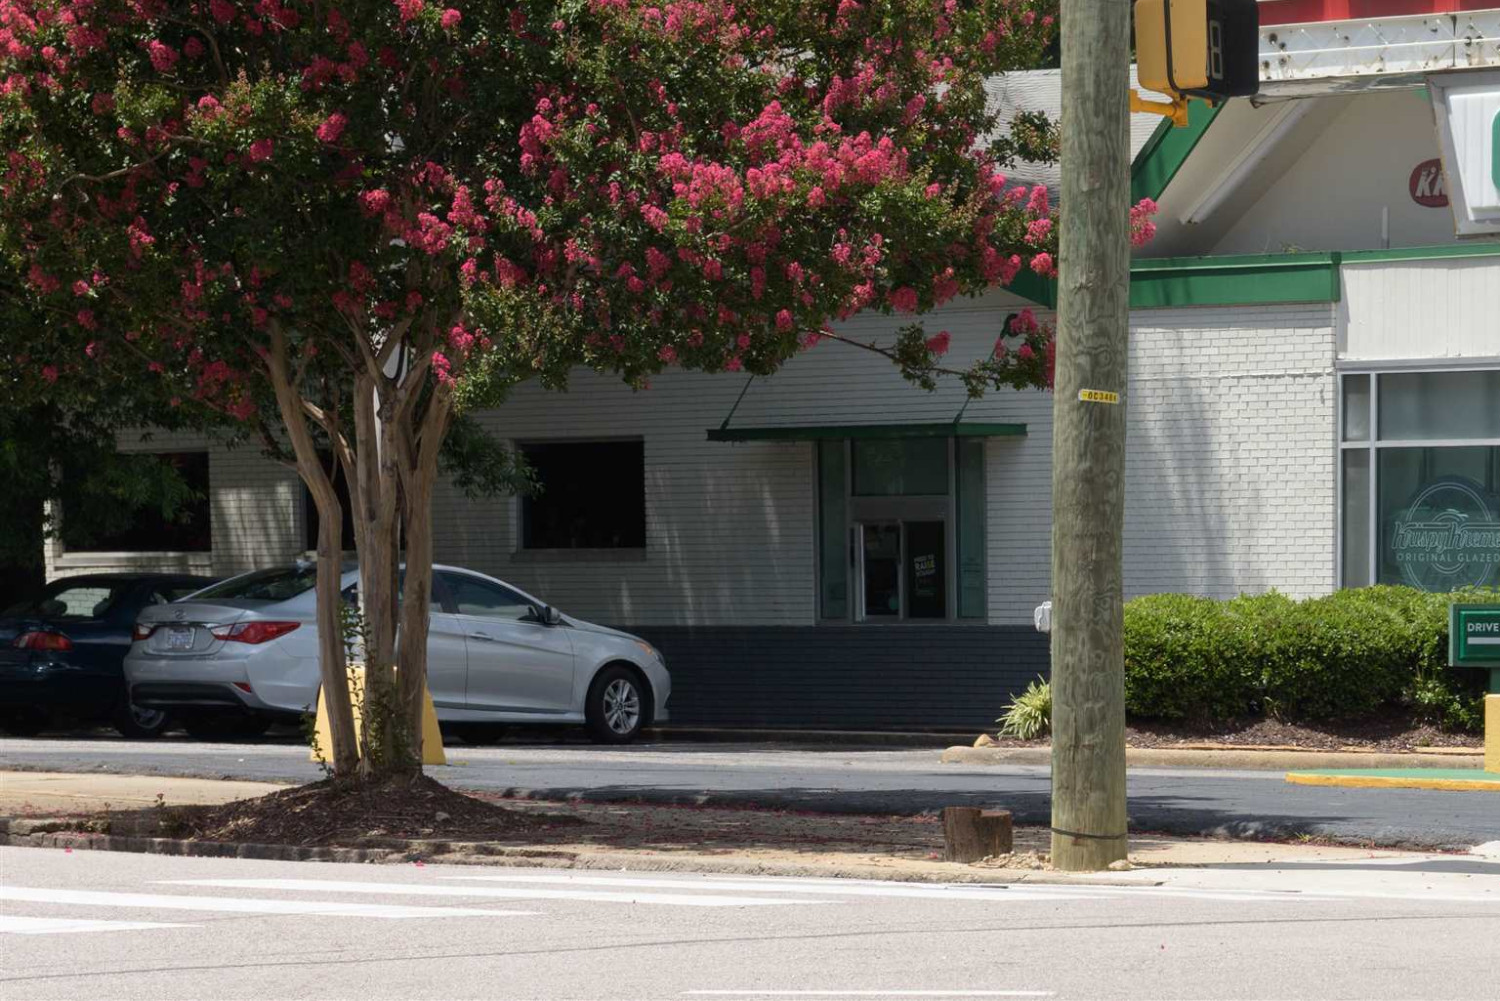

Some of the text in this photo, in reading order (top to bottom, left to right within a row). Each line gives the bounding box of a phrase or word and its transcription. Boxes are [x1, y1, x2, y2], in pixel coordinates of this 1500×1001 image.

[1396, 553, 1500, 563] ORIGINAL GLAZED
[1467, 622, 1499, 632] DRIVE
